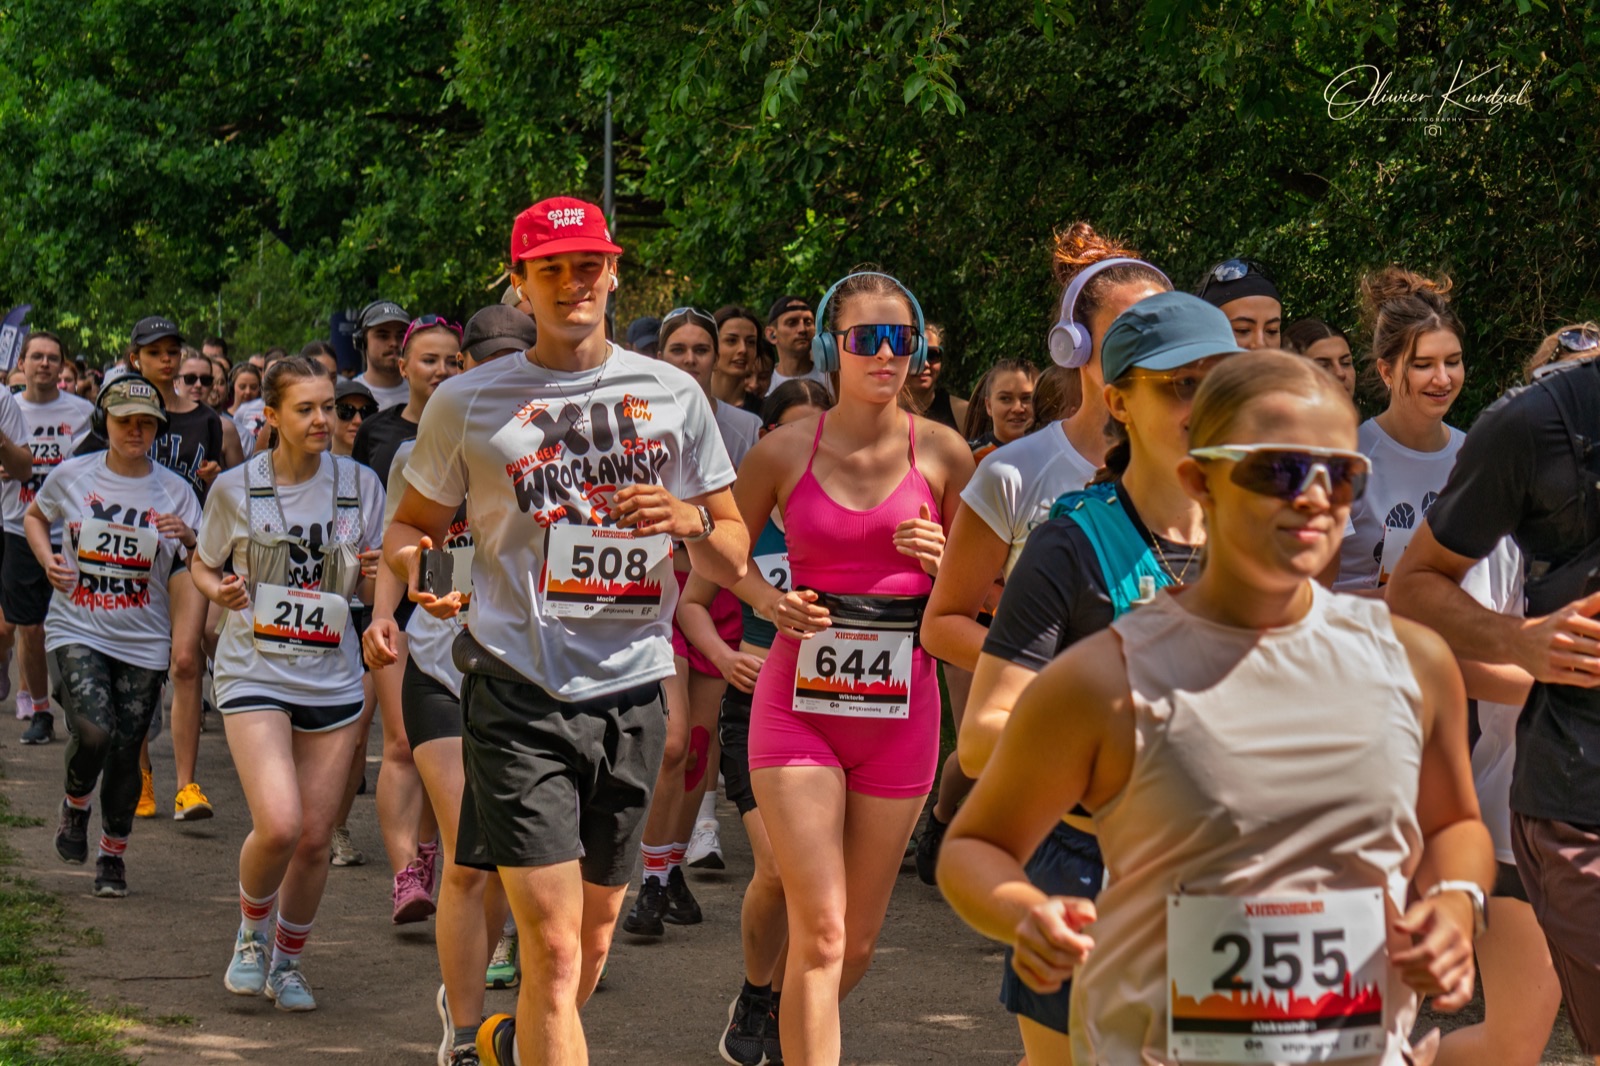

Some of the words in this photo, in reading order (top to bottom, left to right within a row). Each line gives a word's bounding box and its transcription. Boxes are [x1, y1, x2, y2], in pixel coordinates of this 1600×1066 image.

[554, 216, 583, 229] MORE
[564, 208, 585, 217] ONE
[623, 394, 649, 410] FUN
[624, 407, 652, 421] RUN
[530, 401, 638, 456] XII
[30, 443, 60, 458] 723
[145, 433, 205, 491] CLA
[506, 455, 529, 478] RUN
[535, 444, 562, 461] HELP
[95, 532, 138, 557] 215
[571, 545, 648, 582] 508
[596, 596, 616, 604] Maciej
[273, 600, 324, 631] 214
[641, 607, 652, 616] EF
[816, 645, 892, 681] 644
[889, 705, 900, 714] EF
[1212, 929, 1349, 992] 255
